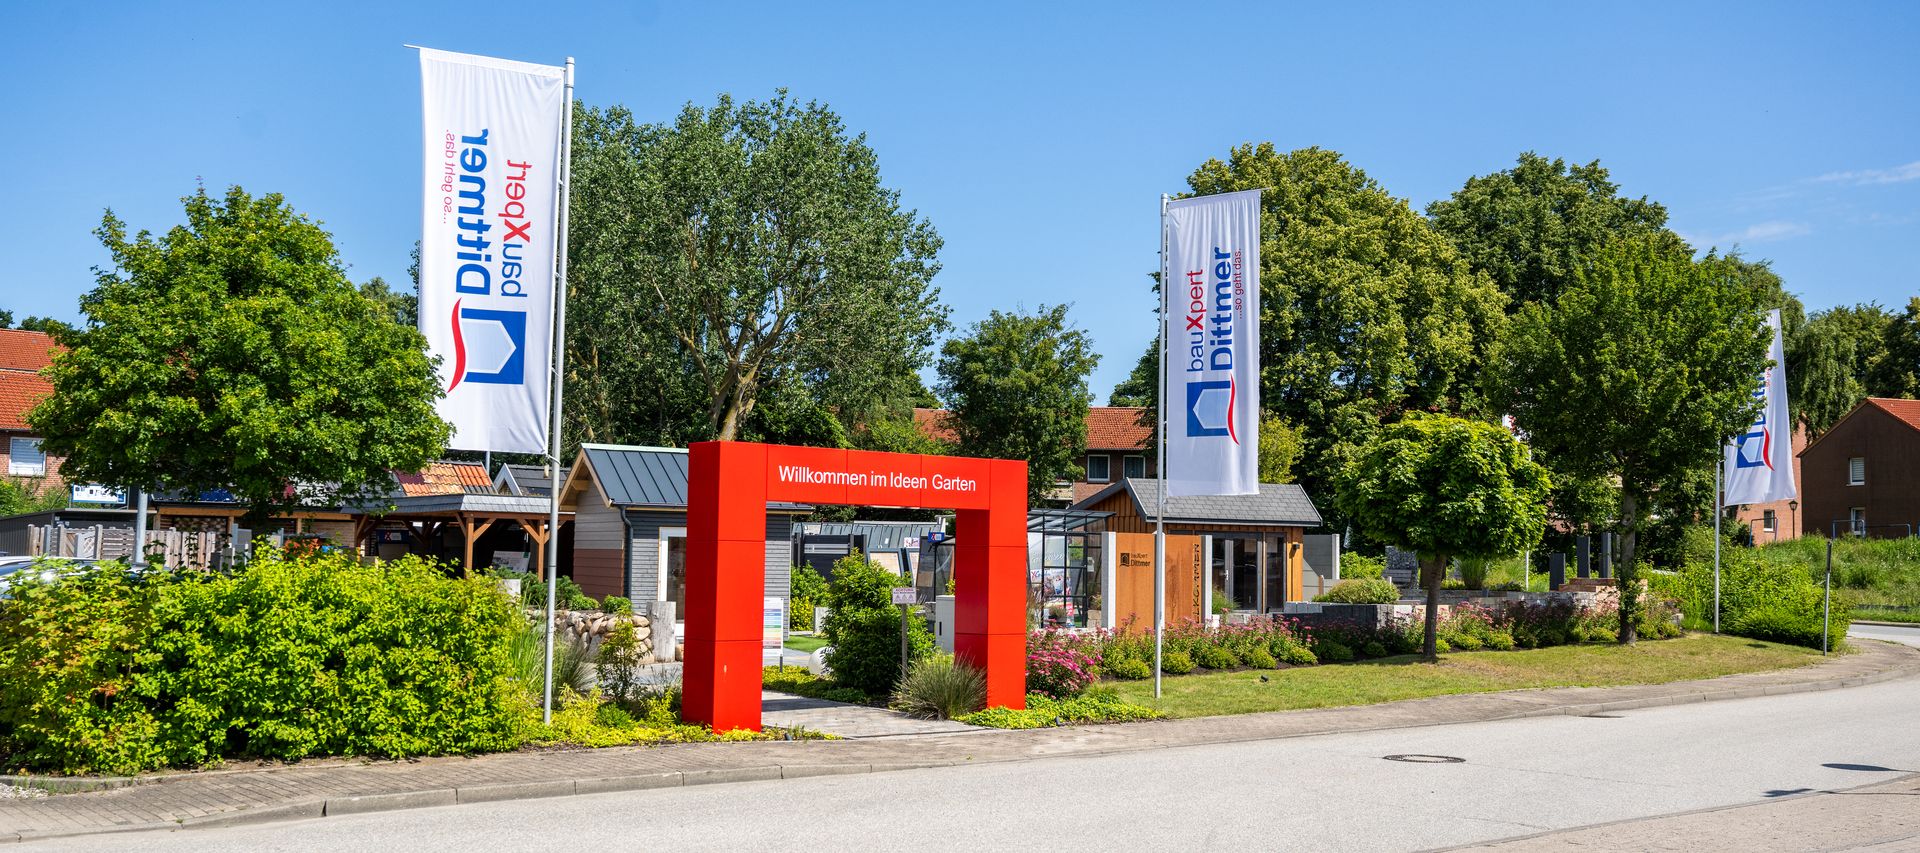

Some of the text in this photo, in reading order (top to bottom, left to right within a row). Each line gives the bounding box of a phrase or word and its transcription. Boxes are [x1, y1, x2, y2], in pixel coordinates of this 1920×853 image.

[1233, 248, 1242, 271] das.
[1233, 272, 1243, 296] geht
[1186, 269, 1206, 372] bauXpert
[1210, 246, 1233, 371] Dittmer
[779, 465, 976, 492] Willkommen im Ideen Garten
